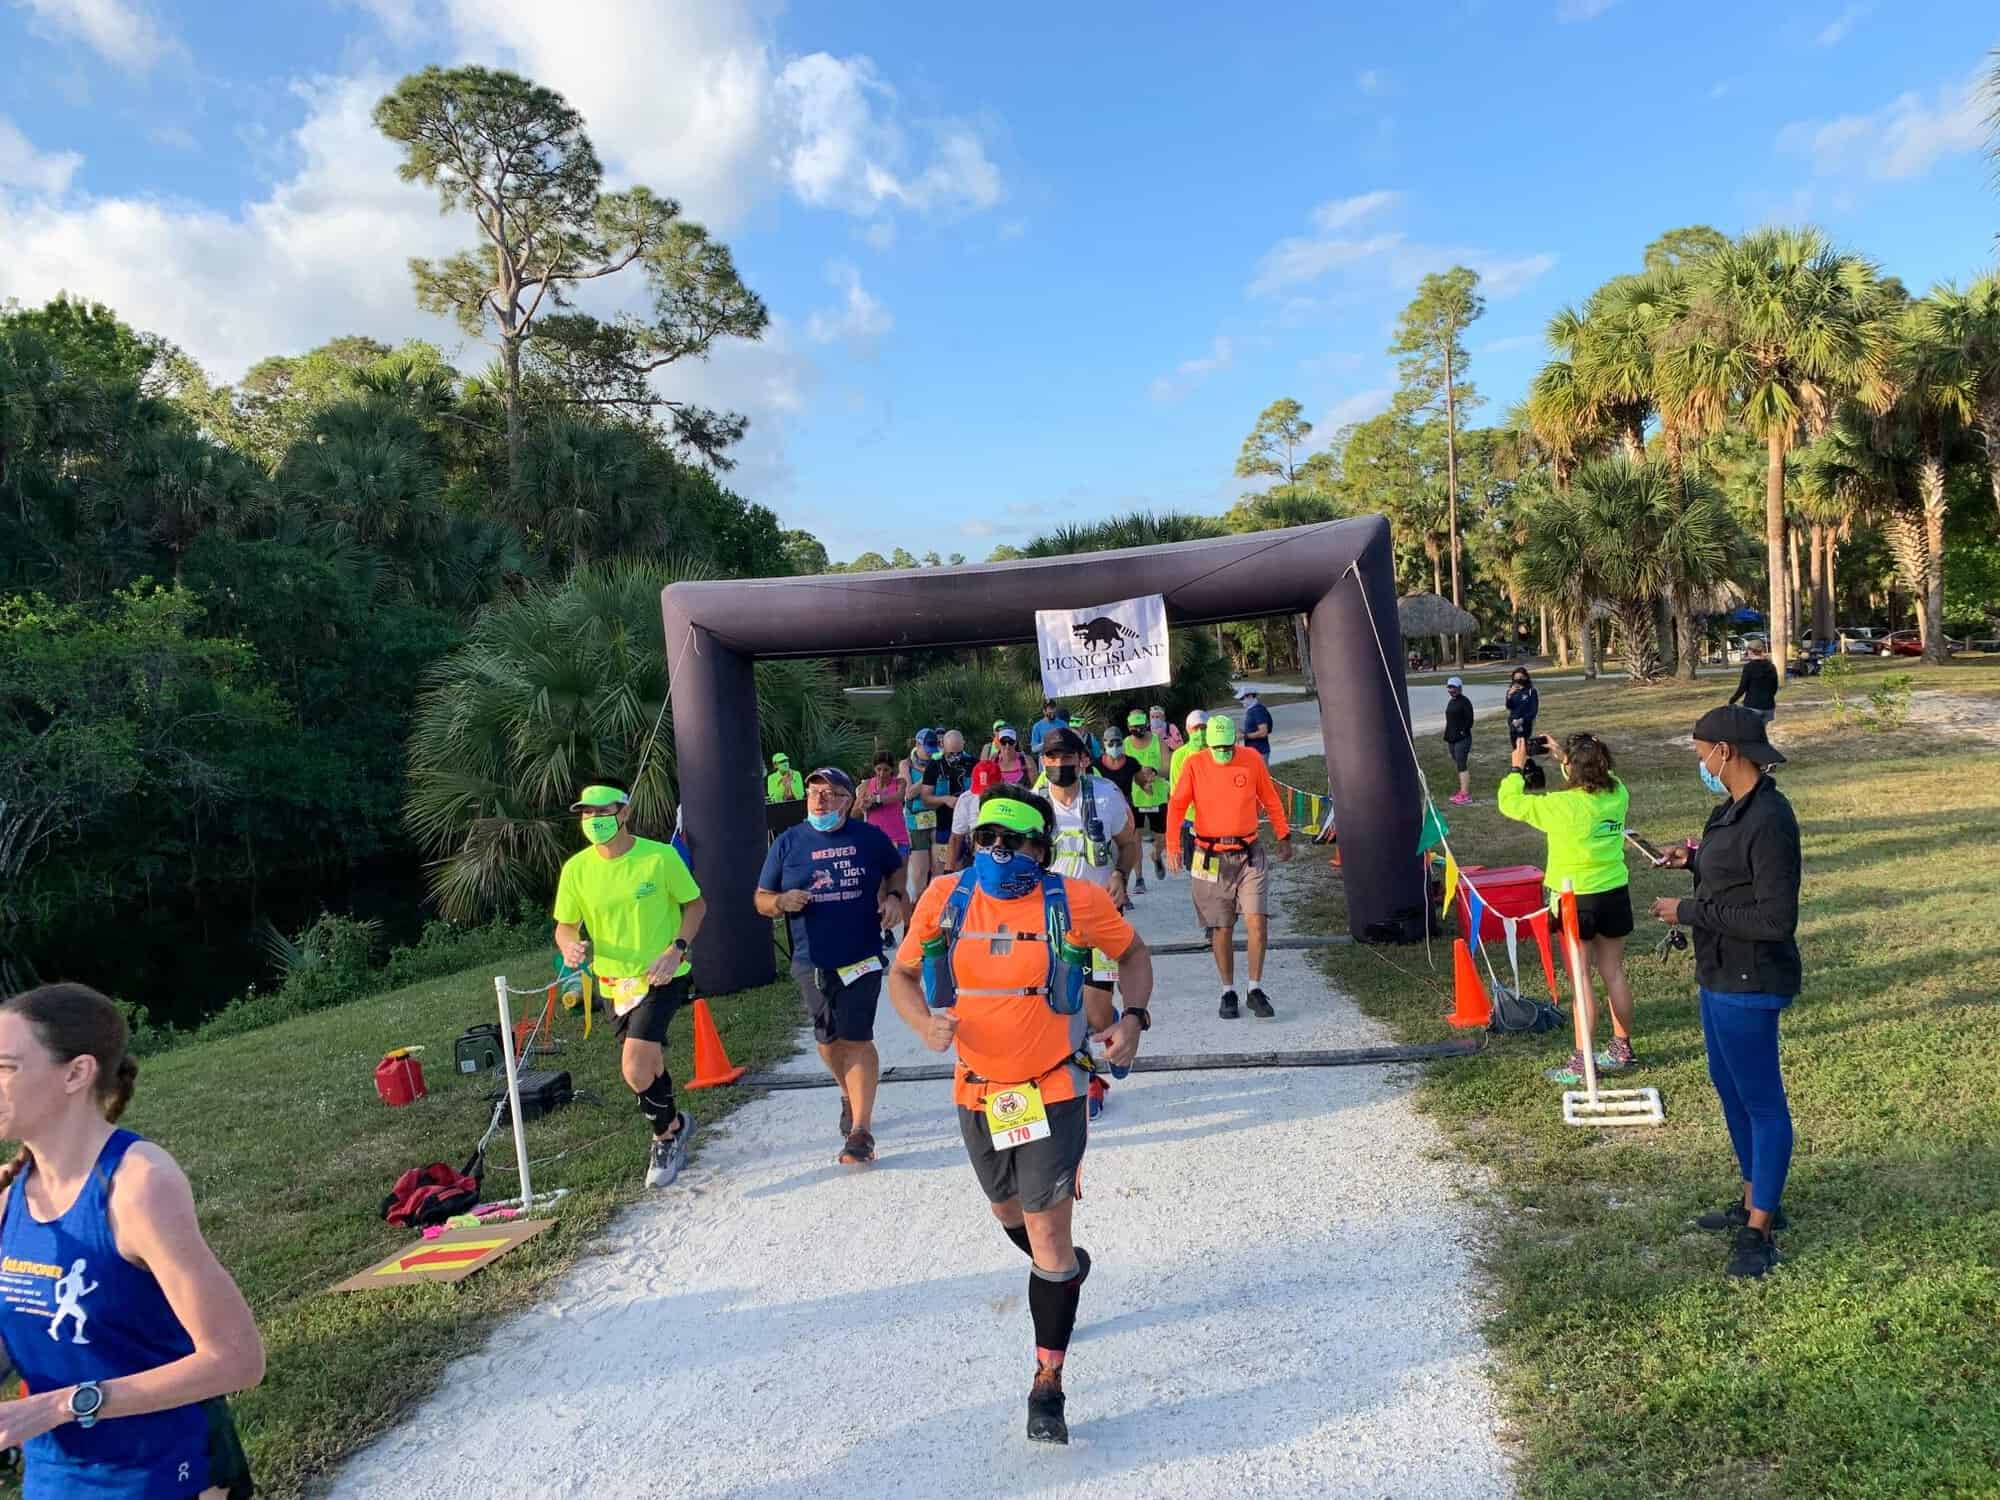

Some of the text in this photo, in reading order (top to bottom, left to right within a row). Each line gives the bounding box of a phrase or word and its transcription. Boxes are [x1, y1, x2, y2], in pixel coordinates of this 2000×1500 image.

[1046, 654, 1101, 671] PICNIC
[1077, 663, 1134, 681] ULTRA
[843, 867, 866, 877] UGLY
[1008, 1126, 1031, 1144] 170
